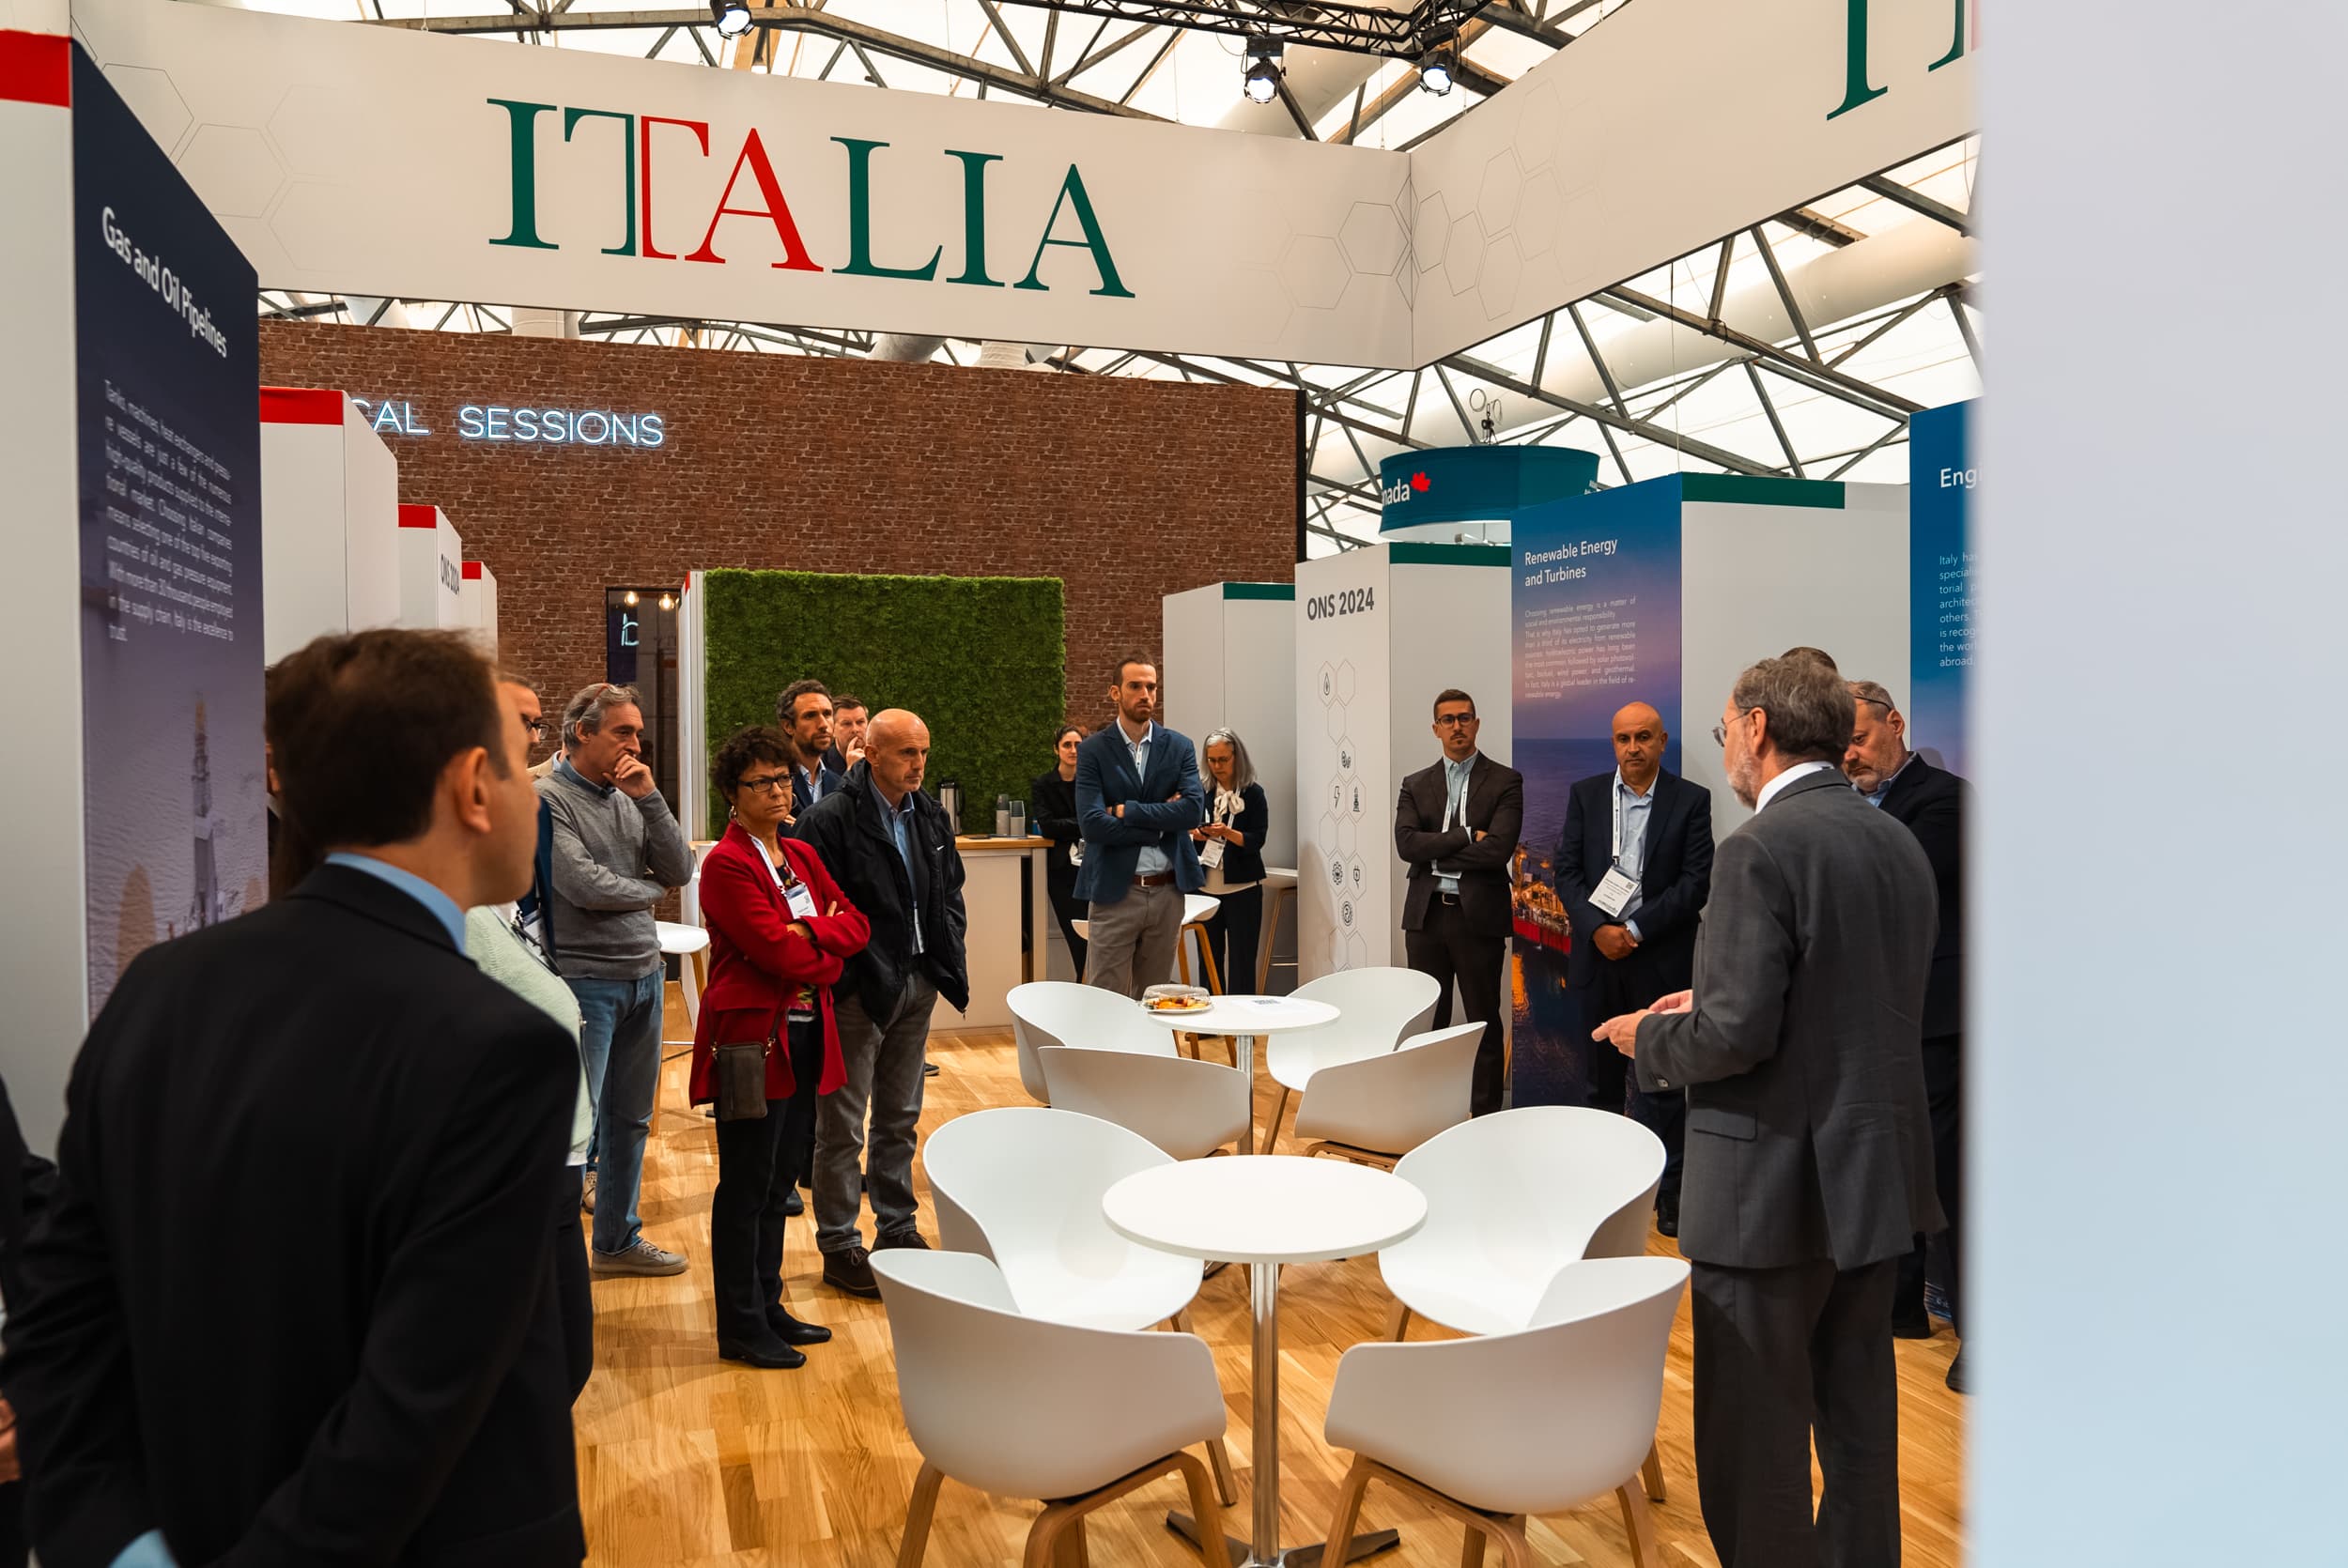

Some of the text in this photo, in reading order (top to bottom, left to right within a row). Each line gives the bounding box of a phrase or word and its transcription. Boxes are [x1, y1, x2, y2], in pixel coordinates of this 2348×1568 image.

[487, 98, 1135, 299] ITALIA
[102, 206, 228, 359] Gas and Oil Pipelines
[459, 406, 664, 446] SESSIONS
[1524, 538, 1618, 566] Renewable Energy
[1939, 552, 1958, 567] Italy
[1524, 565, 1586, 587] and Turbines
[1939, 581, 1963, 594] torial
[1307, 586, 1375, 621] ONS 2024
[1939, 628, 1947, 638] is
[1939, 641, 1954, 653] the
